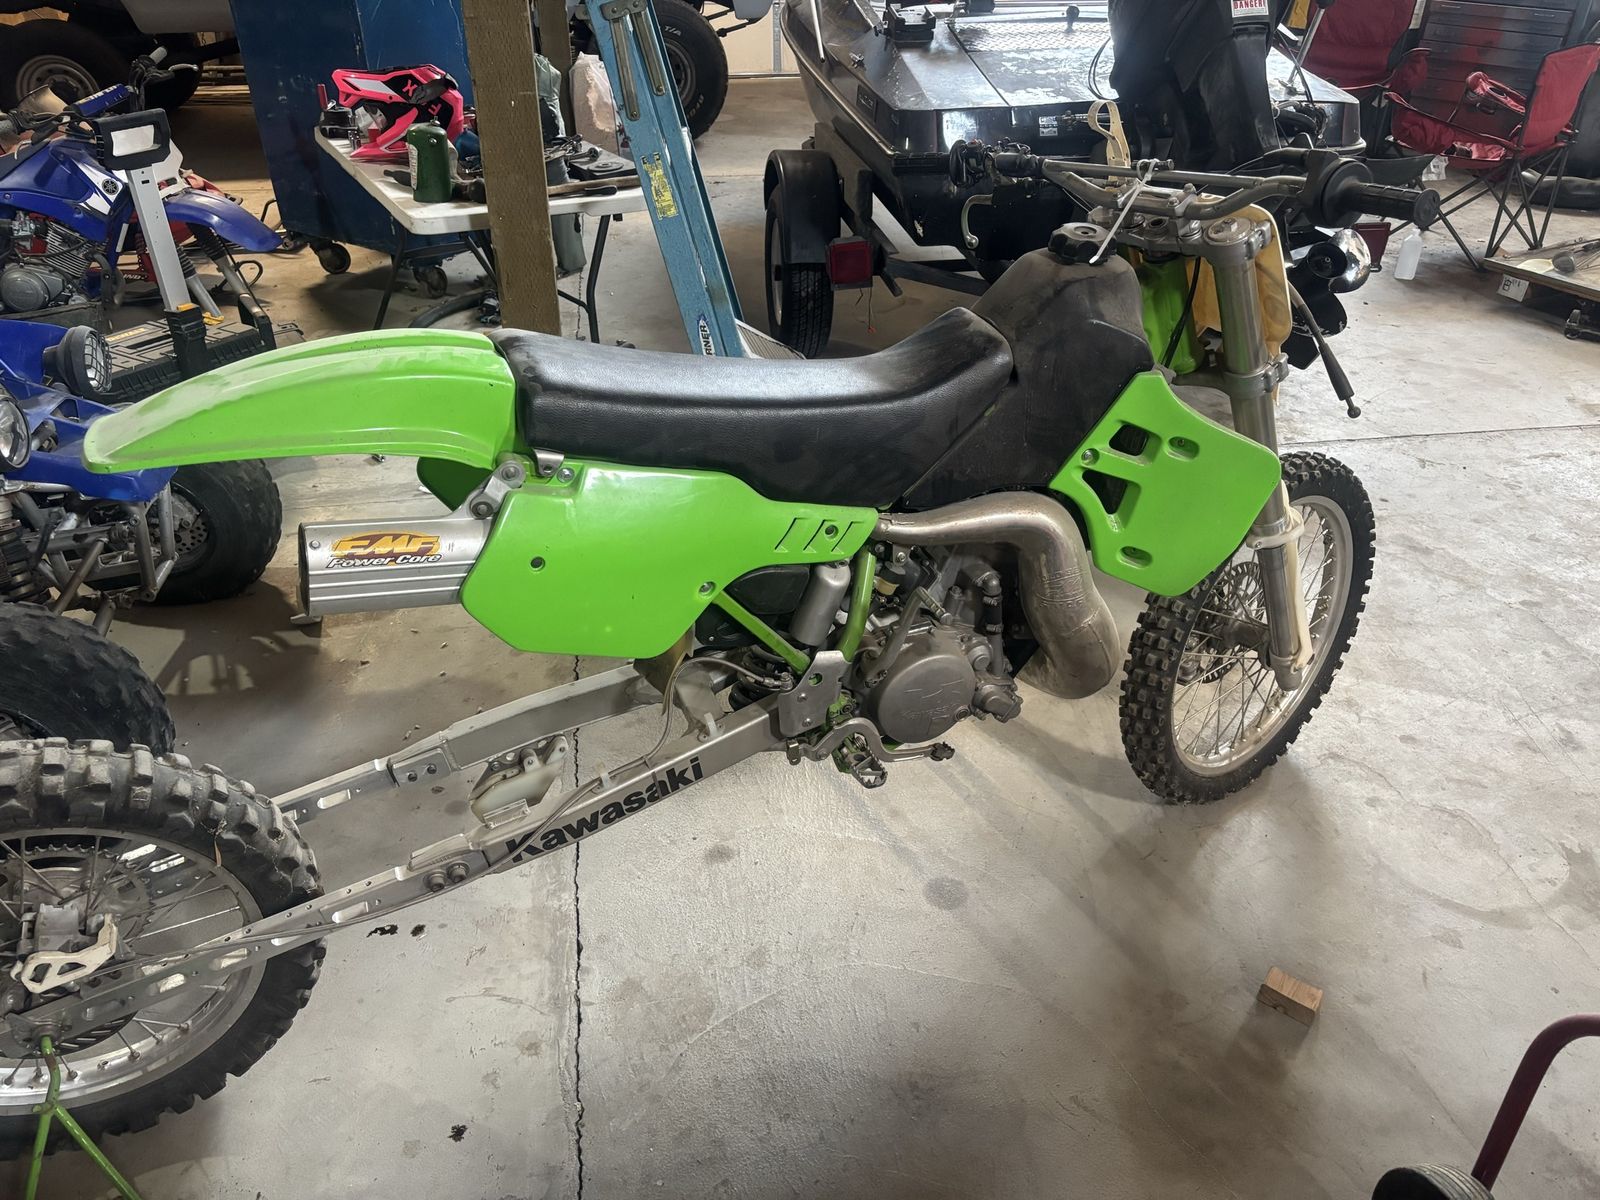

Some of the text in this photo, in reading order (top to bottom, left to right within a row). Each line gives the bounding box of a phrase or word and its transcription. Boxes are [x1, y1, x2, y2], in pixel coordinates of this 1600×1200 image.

[332, 534, 440, 557] FMF
[326, 553, 442, 569] Power Core
[505, 756, 704, 864] Kawasaki
